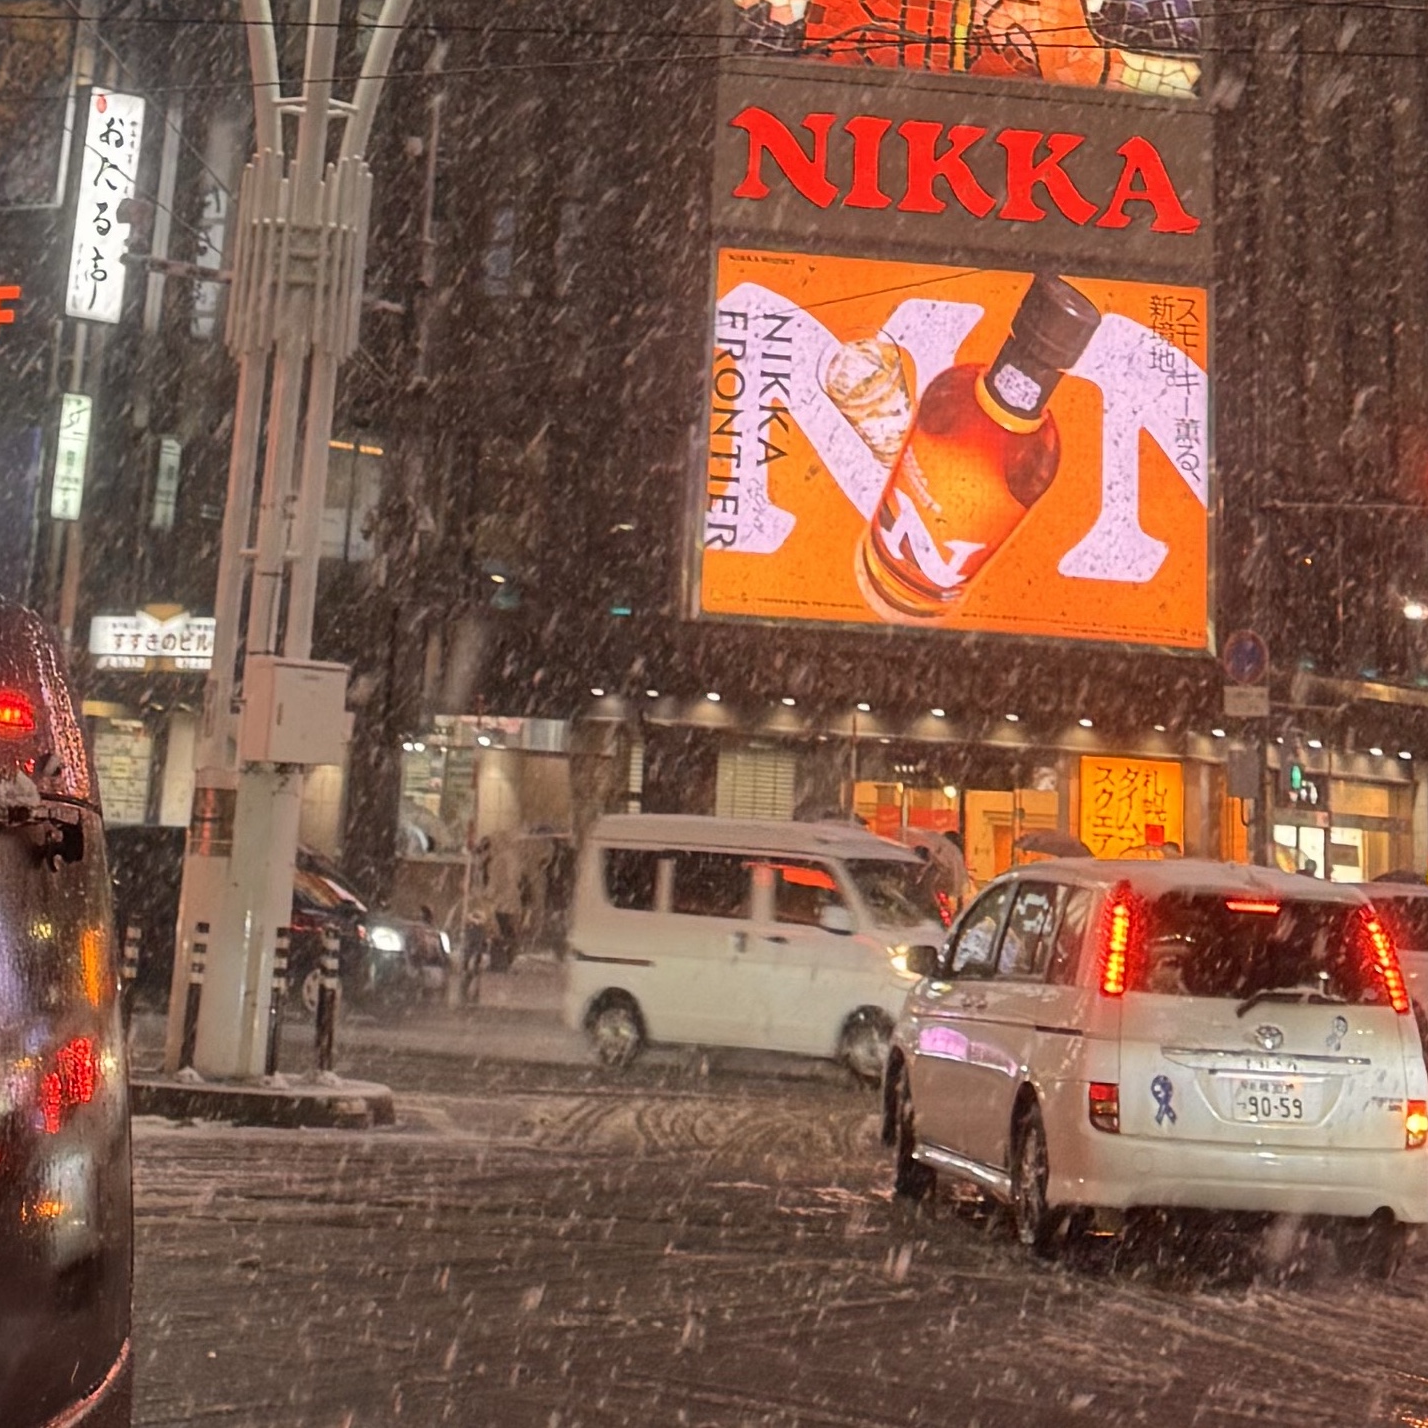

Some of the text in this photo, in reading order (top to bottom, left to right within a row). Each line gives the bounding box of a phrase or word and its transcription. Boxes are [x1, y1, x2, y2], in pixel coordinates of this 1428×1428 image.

[731, 105, 1201, 235] NIKKA
[1148, 294, 1176, 387] 新境地。
[1175, 297, 1201, 483] スモーキー薫る、
[704, 309, 794, 552] NIKKA FRONTIER
[112, 632, 213, 653] すすきのビル
